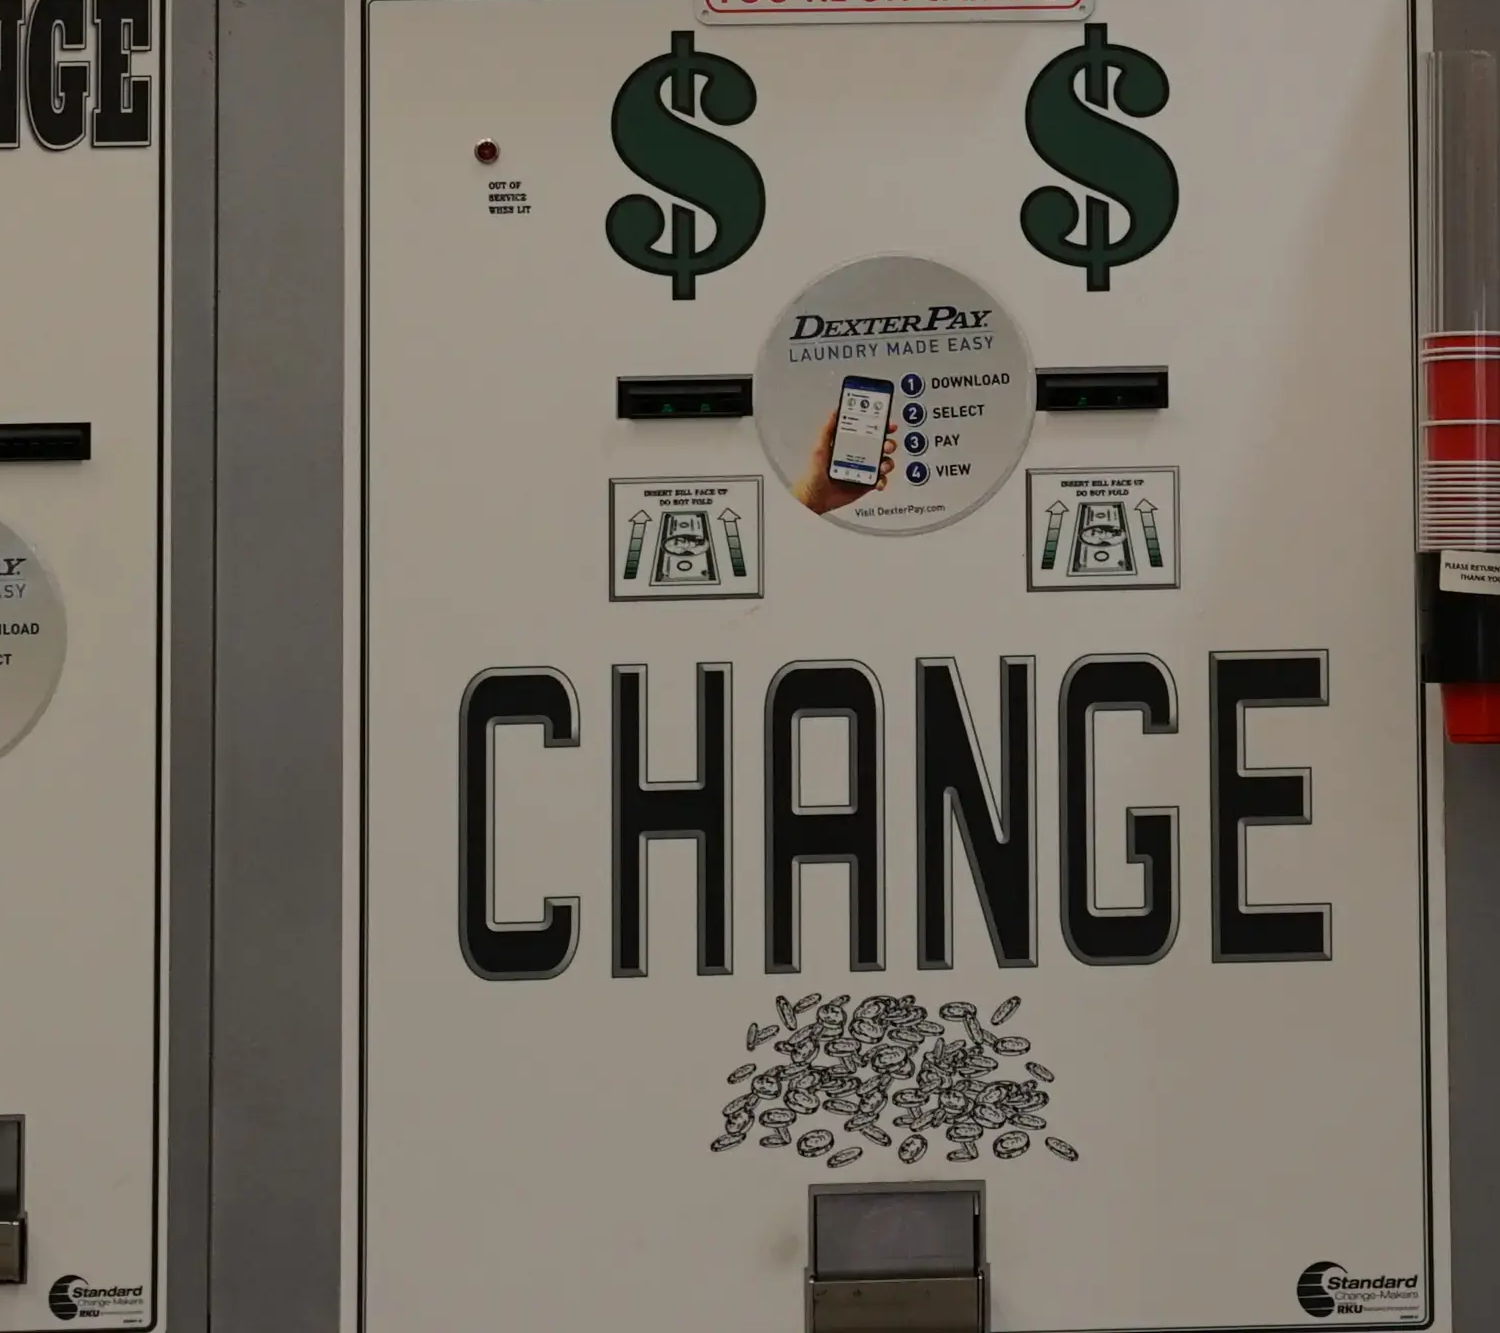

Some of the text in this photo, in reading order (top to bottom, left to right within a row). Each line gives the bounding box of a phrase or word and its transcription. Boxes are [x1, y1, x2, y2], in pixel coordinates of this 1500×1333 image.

[1019, 22, 1180, 292] $
[605, 30, 767, 301] $
[788, 336, 994, 364] LAUNDRY MADE EASY
[931, 371, 1011, 389] DOWNLOAD
[932, 404, 985, 420] SELECT
[934, 433, 960, 448] PAY
[935, 463, 972, 478] VIEW
[854, 502, 946, 518] Visit DexterPay.com
[1444, 562, 1468, 571] PLEASE
[1470, 564, 1500, 573] RETURN
[1460, 573, 1485, 582] THANK
[457, 648, 1333, 981] CHANGE
[1327, 1274, 1418, 1290] Standard
[72, 1285, 143, 1298] Standard
[1337, 1304, 1363, 1314] RKU
